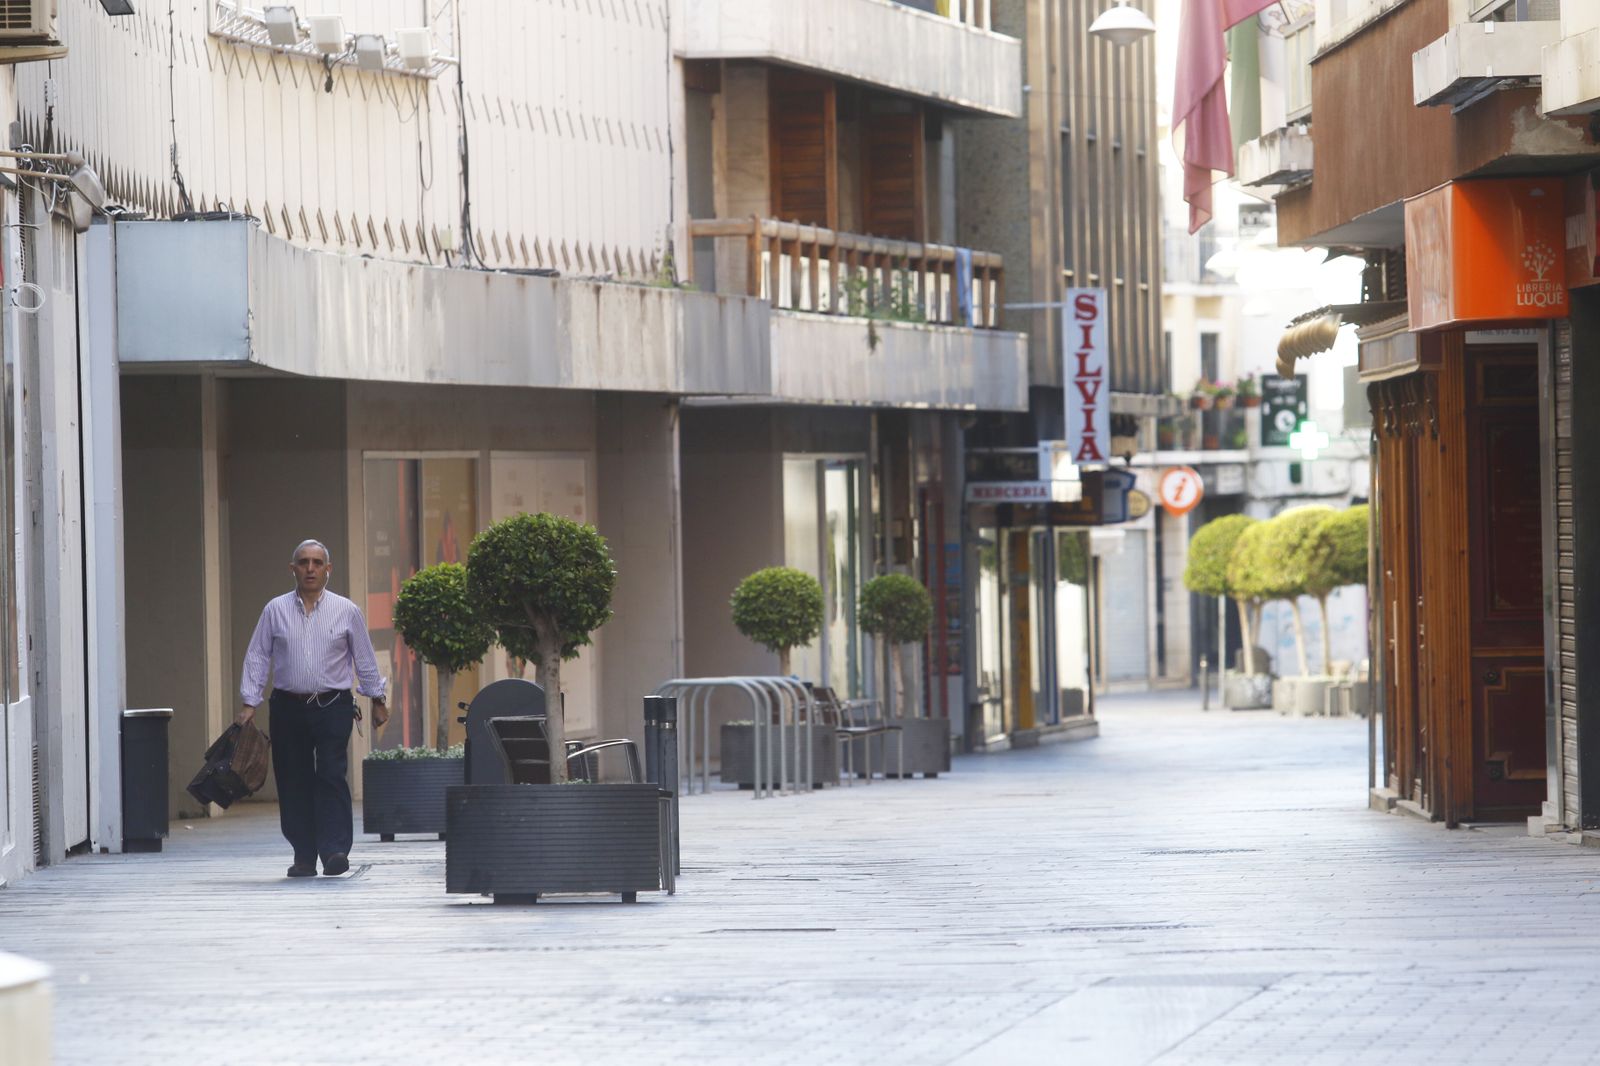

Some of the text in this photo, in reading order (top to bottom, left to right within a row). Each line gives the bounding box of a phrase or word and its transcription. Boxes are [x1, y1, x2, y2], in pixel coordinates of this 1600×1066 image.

[1518, 283, 1563, 292] LIBRERIA
[1518, 293, 1563, 307] LUQUE
[1074, 293, 1103, 462] SILVIA
[972, 486, 1047, 498] MERCERIA
